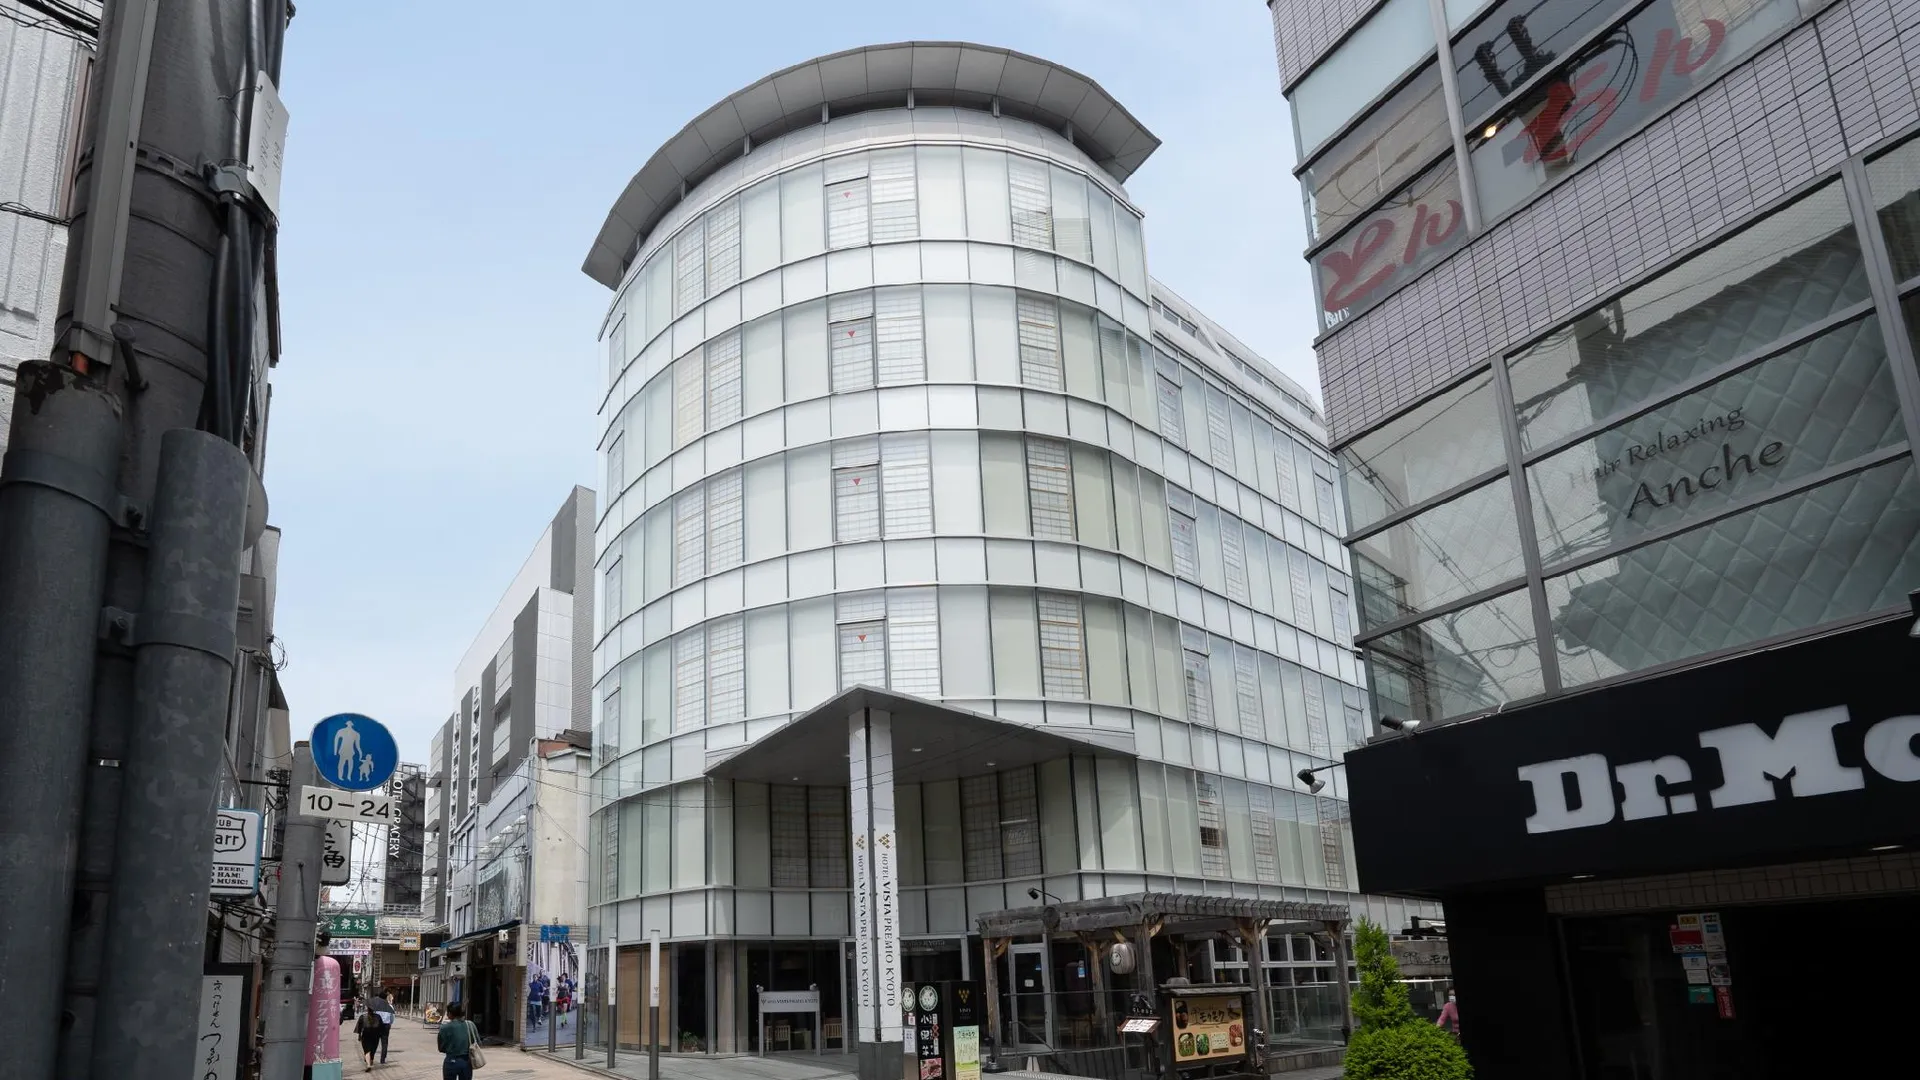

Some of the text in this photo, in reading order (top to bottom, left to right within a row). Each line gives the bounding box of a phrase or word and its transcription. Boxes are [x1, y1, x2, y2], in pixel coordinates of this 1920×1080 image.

[1627, 406, 1746, 466] Relaxing
[1627, 440, 1786, 520] Anche
[217, 819, 232, 827] UB
[389, 808, 402, 859] GRACERY
[860, 919, 868, 965] PREMIO
[881, 853, 895, 1006] HOTEL VISTA PREMIO KYOTO
